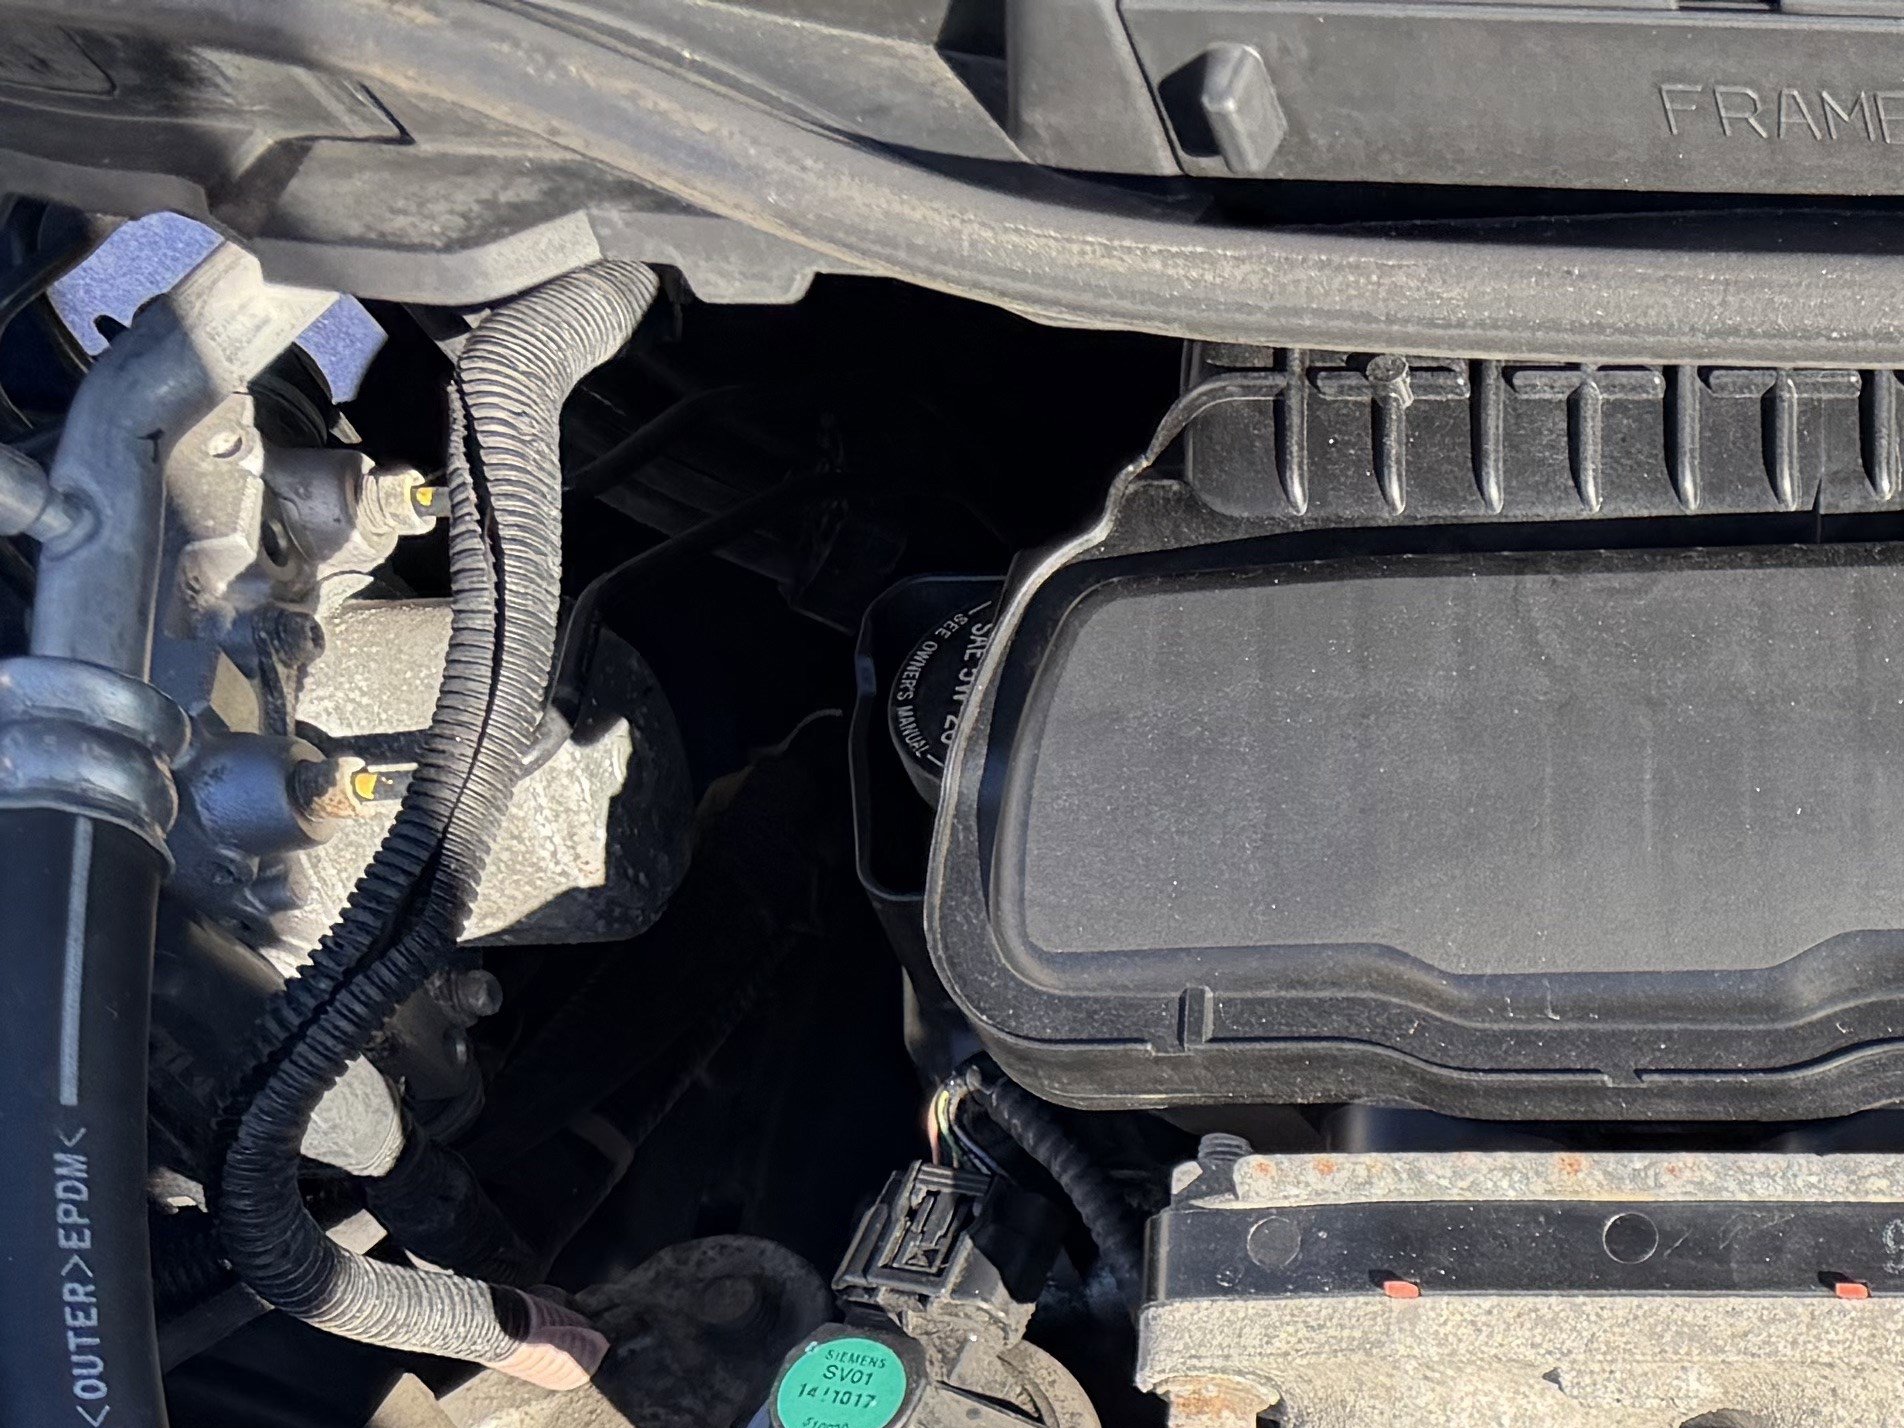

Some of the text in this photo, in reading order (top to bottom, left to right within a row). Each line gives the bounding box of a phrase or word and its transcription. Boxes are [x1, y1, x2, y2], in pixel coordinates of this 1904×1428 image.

[935, 613, 968, 639] SEE
[896, 705, 931, 758] MANUAL
[825, 1349, 887, 1369] SIEMENS
